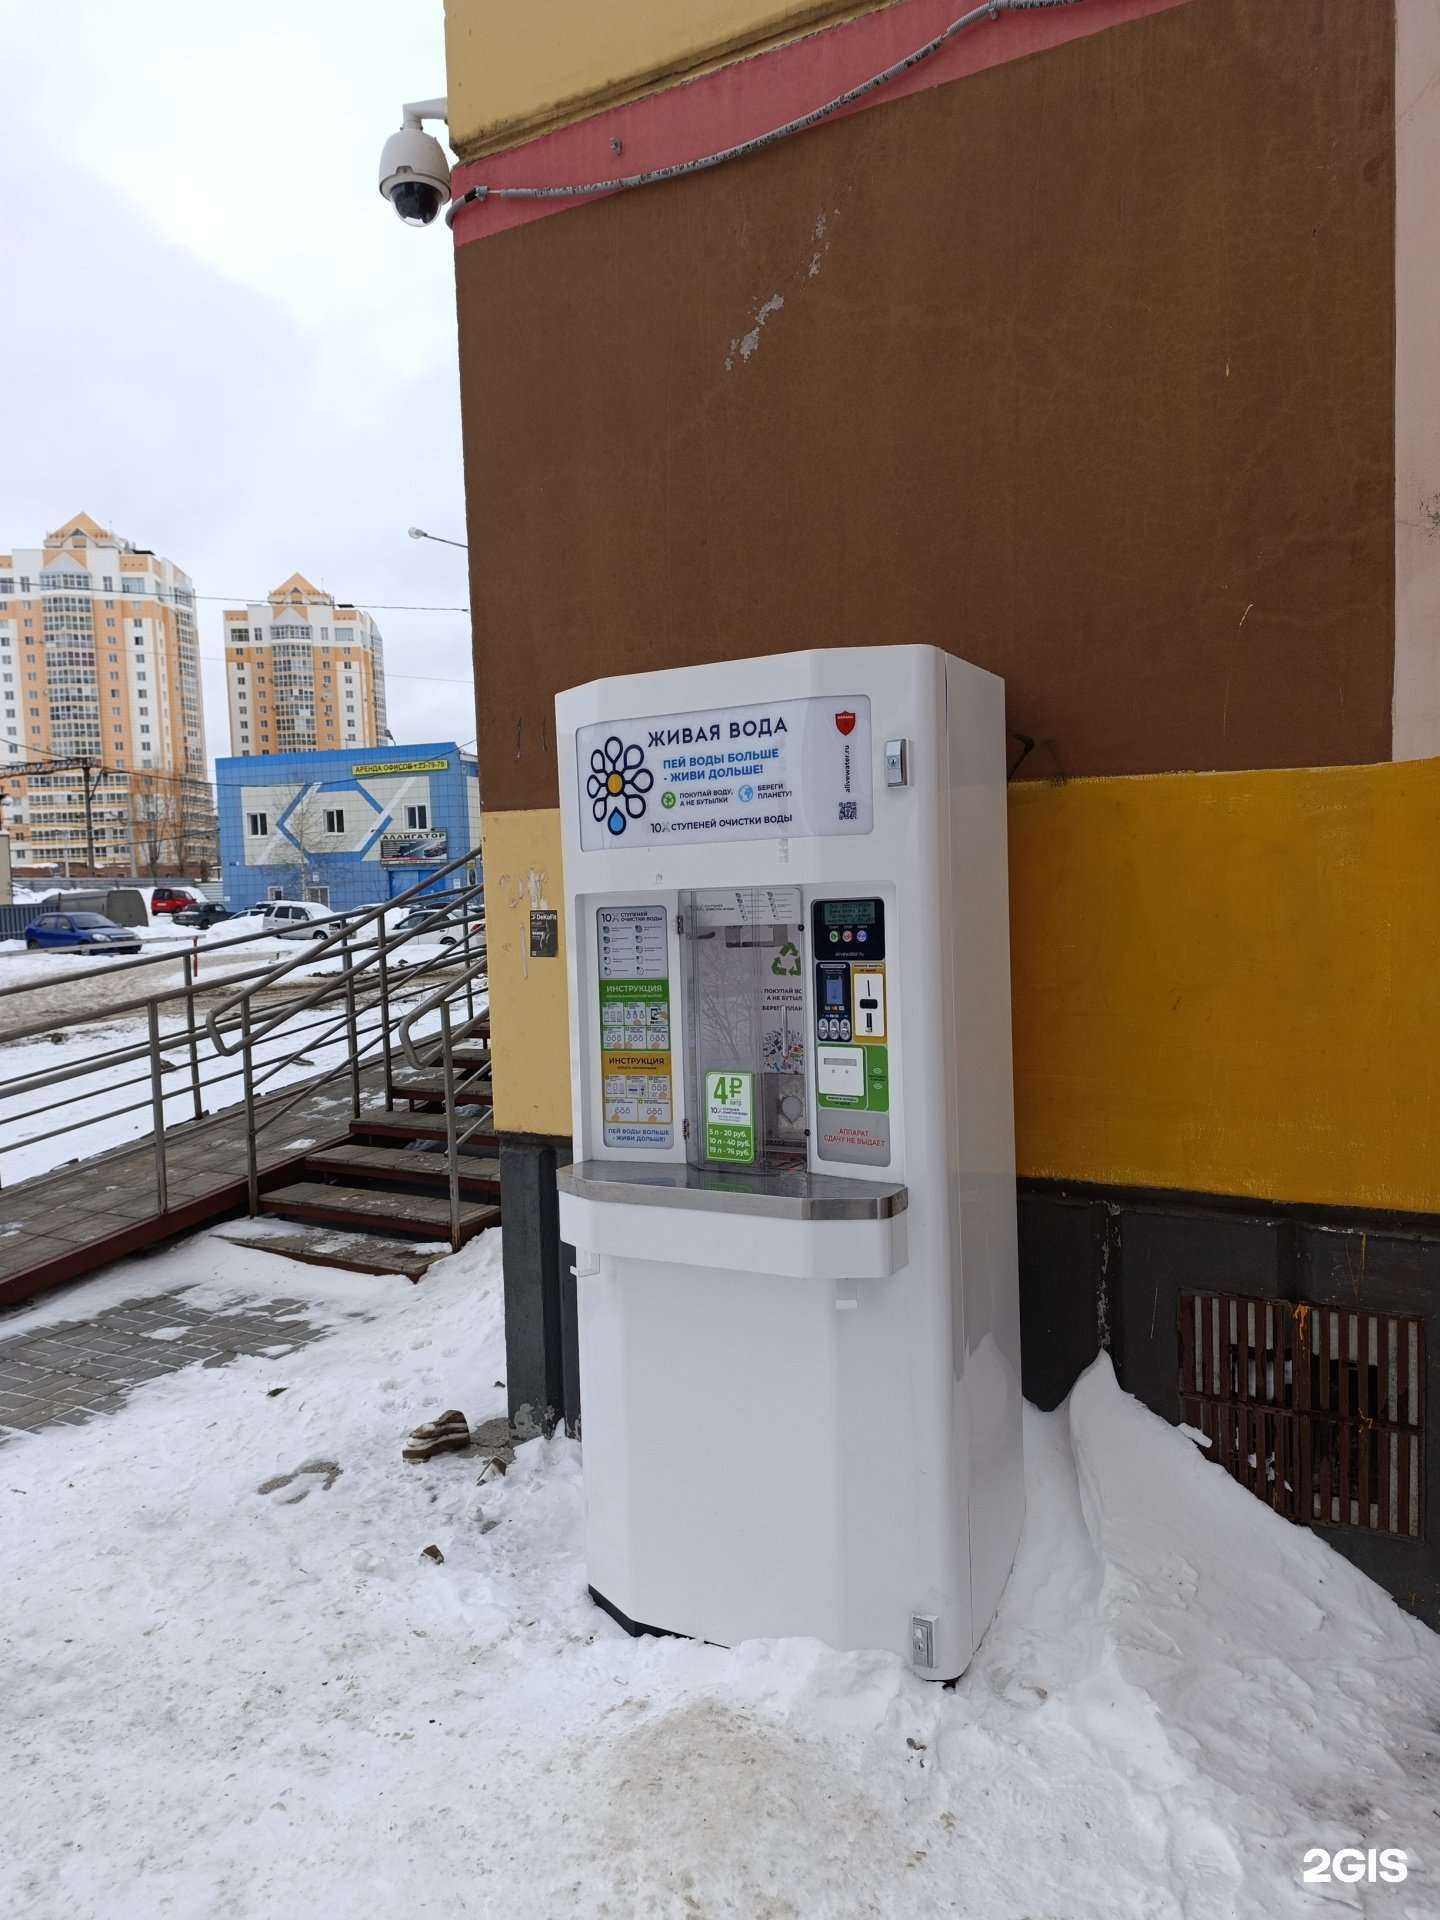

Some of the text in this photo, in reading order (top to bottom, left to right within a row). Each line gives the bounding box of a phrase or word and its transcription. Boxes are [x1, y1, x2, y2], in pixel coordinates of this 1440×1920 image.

[648, 717, 788, 747] ЖИВАЯ ВОДА
[663, 748, 779, 769] ПЕЙ ВОДЫ БОЛЬШЕ
[670, 770, 705, 782] ЖИВИ
[708, 764, 764, 779] ДОЛЬШЕ!
[671, 819, 717, 831] СТУПЕНЕЙ
[719, 816, 761, 827] ОЧИСТКИ
[764, 814, 793, 824] ВОДЫ
[383, 832, 446, 840] АЛЛИГАТОР
[606, 984, 663, 993] ИНСТРУКЦИЯ
[608, 1057, 665, 1065] ИНСТРУКЦИЯ
